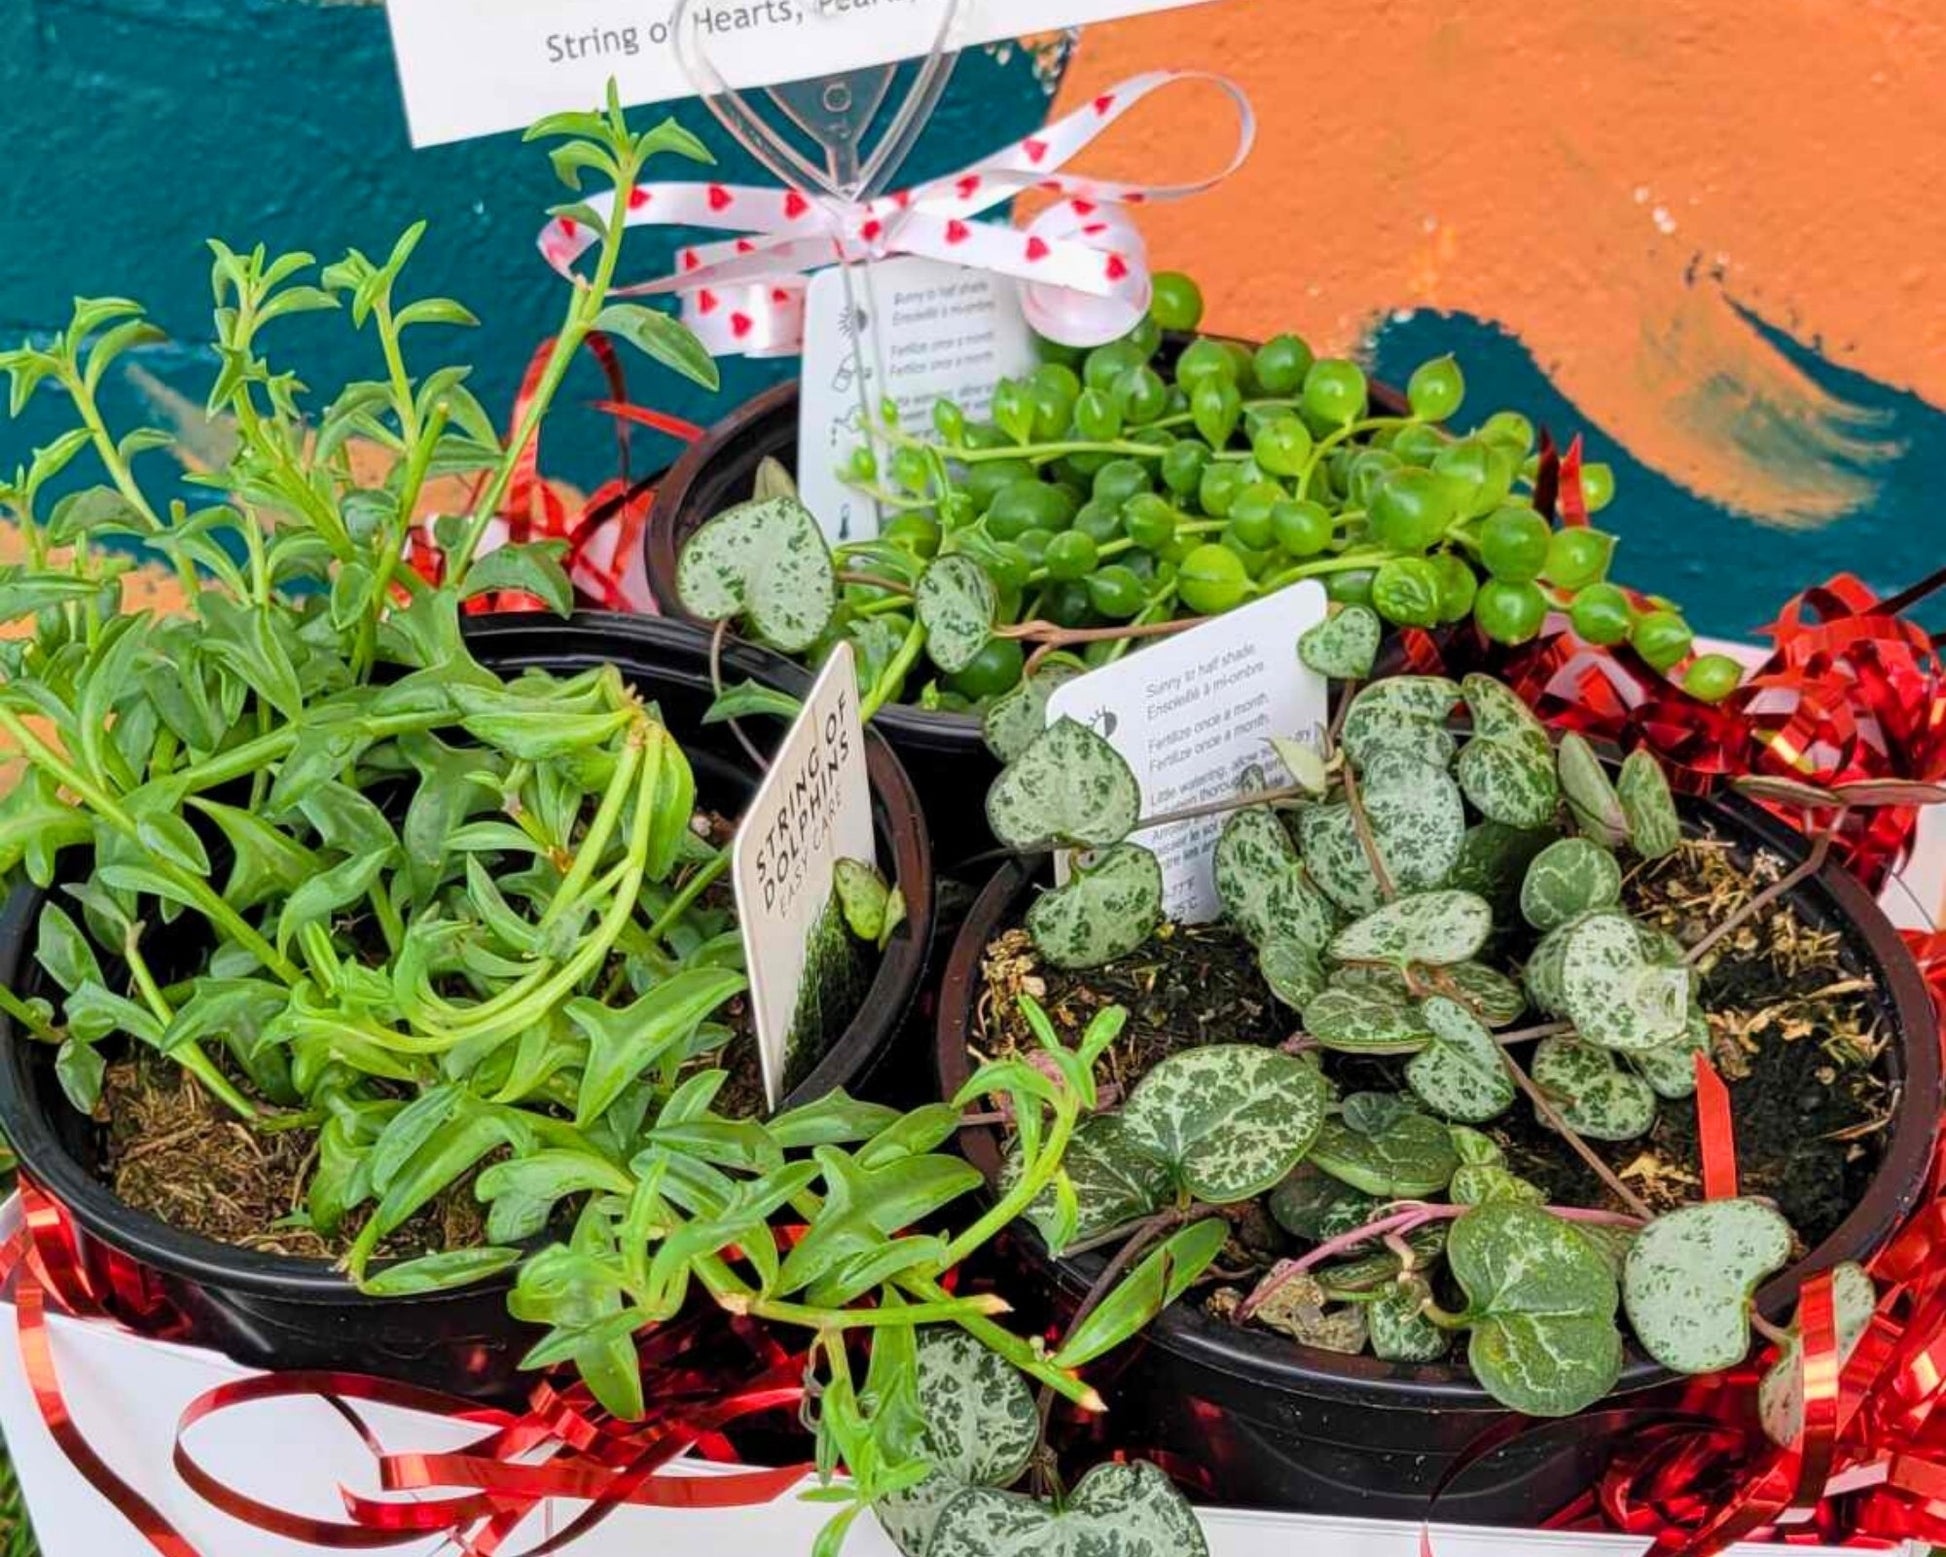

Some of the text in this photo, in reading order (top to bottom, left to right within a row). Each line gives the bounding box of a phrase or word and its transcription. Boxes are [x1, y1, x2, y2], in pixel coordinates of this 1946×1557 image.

[546, 26, 640, 62] String
[1194, 713, 1221, 734] once
[1194, 733, 1222, 754] once
[755, 689, 847, 883] STRING OF
[763, 730, 850, 912] DOLPHINS
